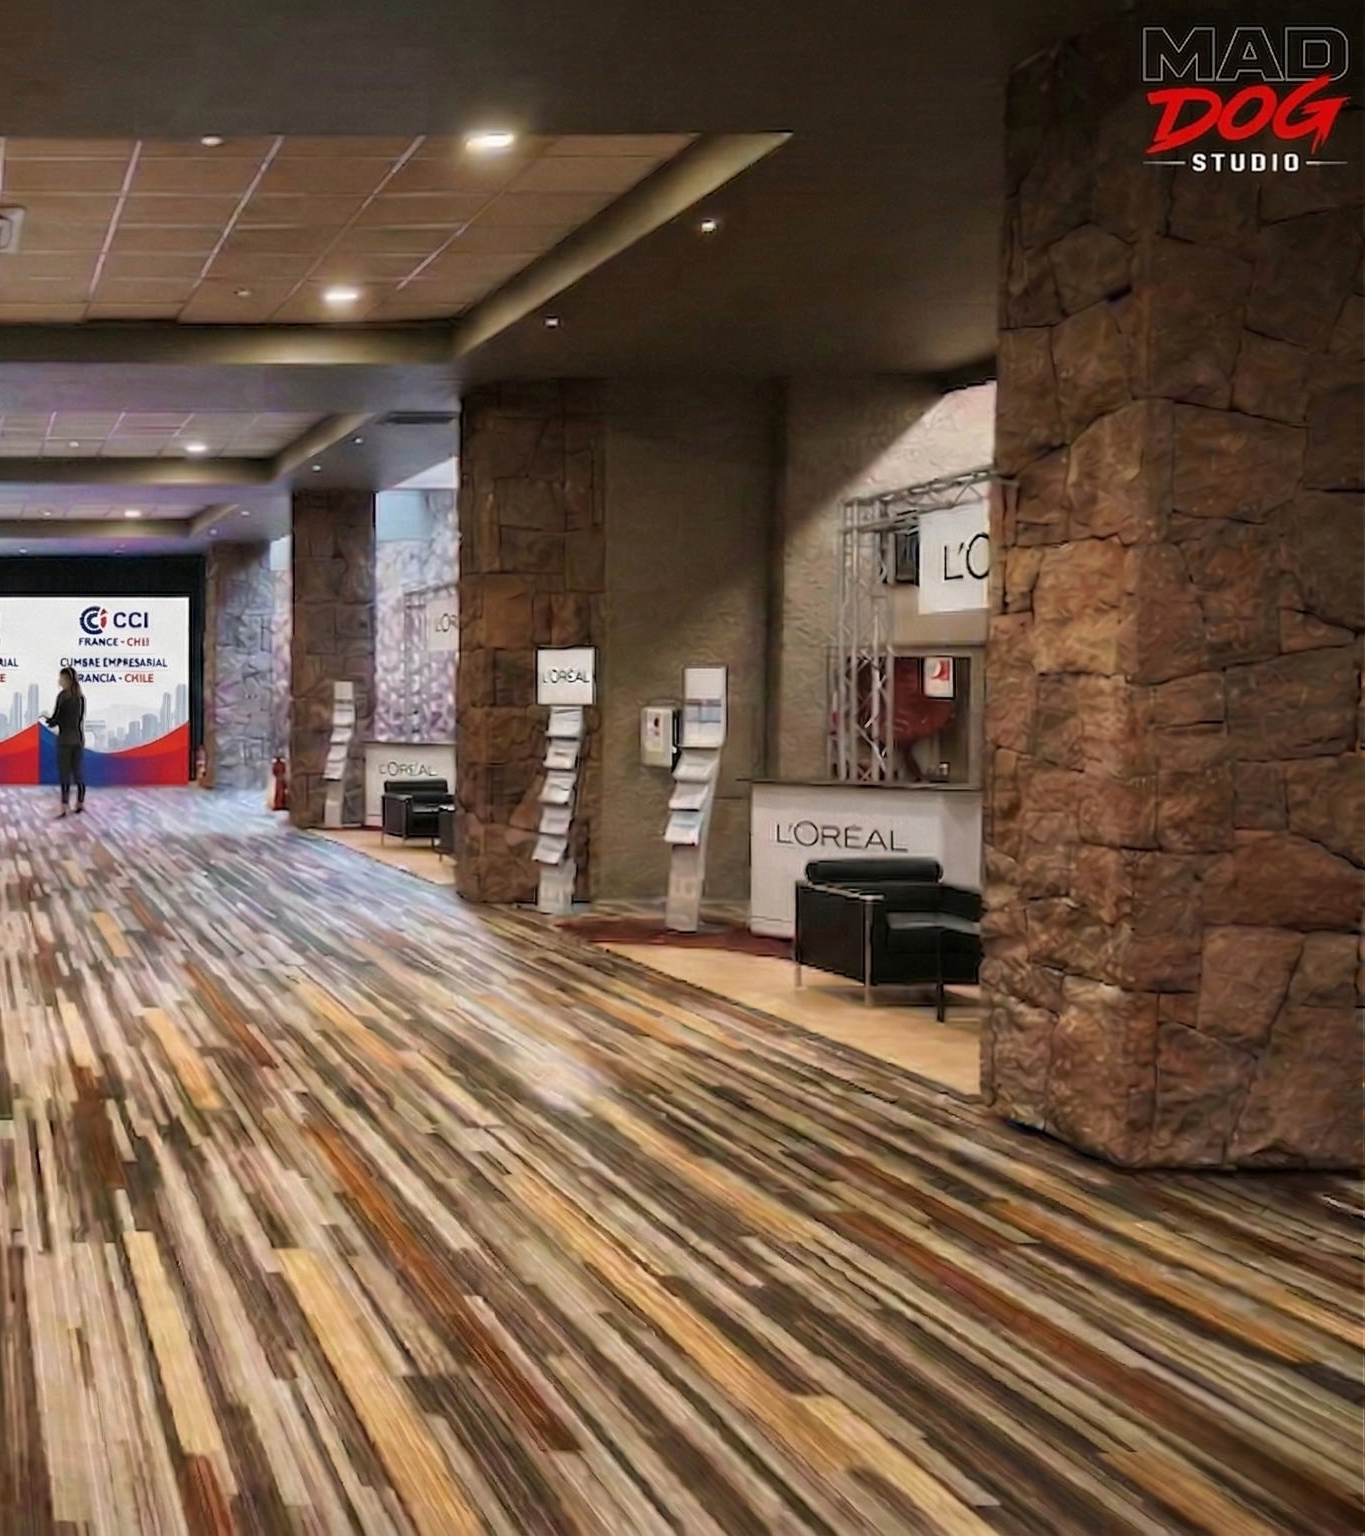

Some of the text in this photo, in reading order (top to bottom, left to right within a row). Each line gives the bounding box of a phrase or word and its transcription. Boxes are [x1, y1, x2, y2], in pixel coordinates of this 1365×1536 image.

[113, 611, 148, 628] CCI
[79, 637, 118, 646] FRANCE
[77, 673, 117, 683] RANCIA
